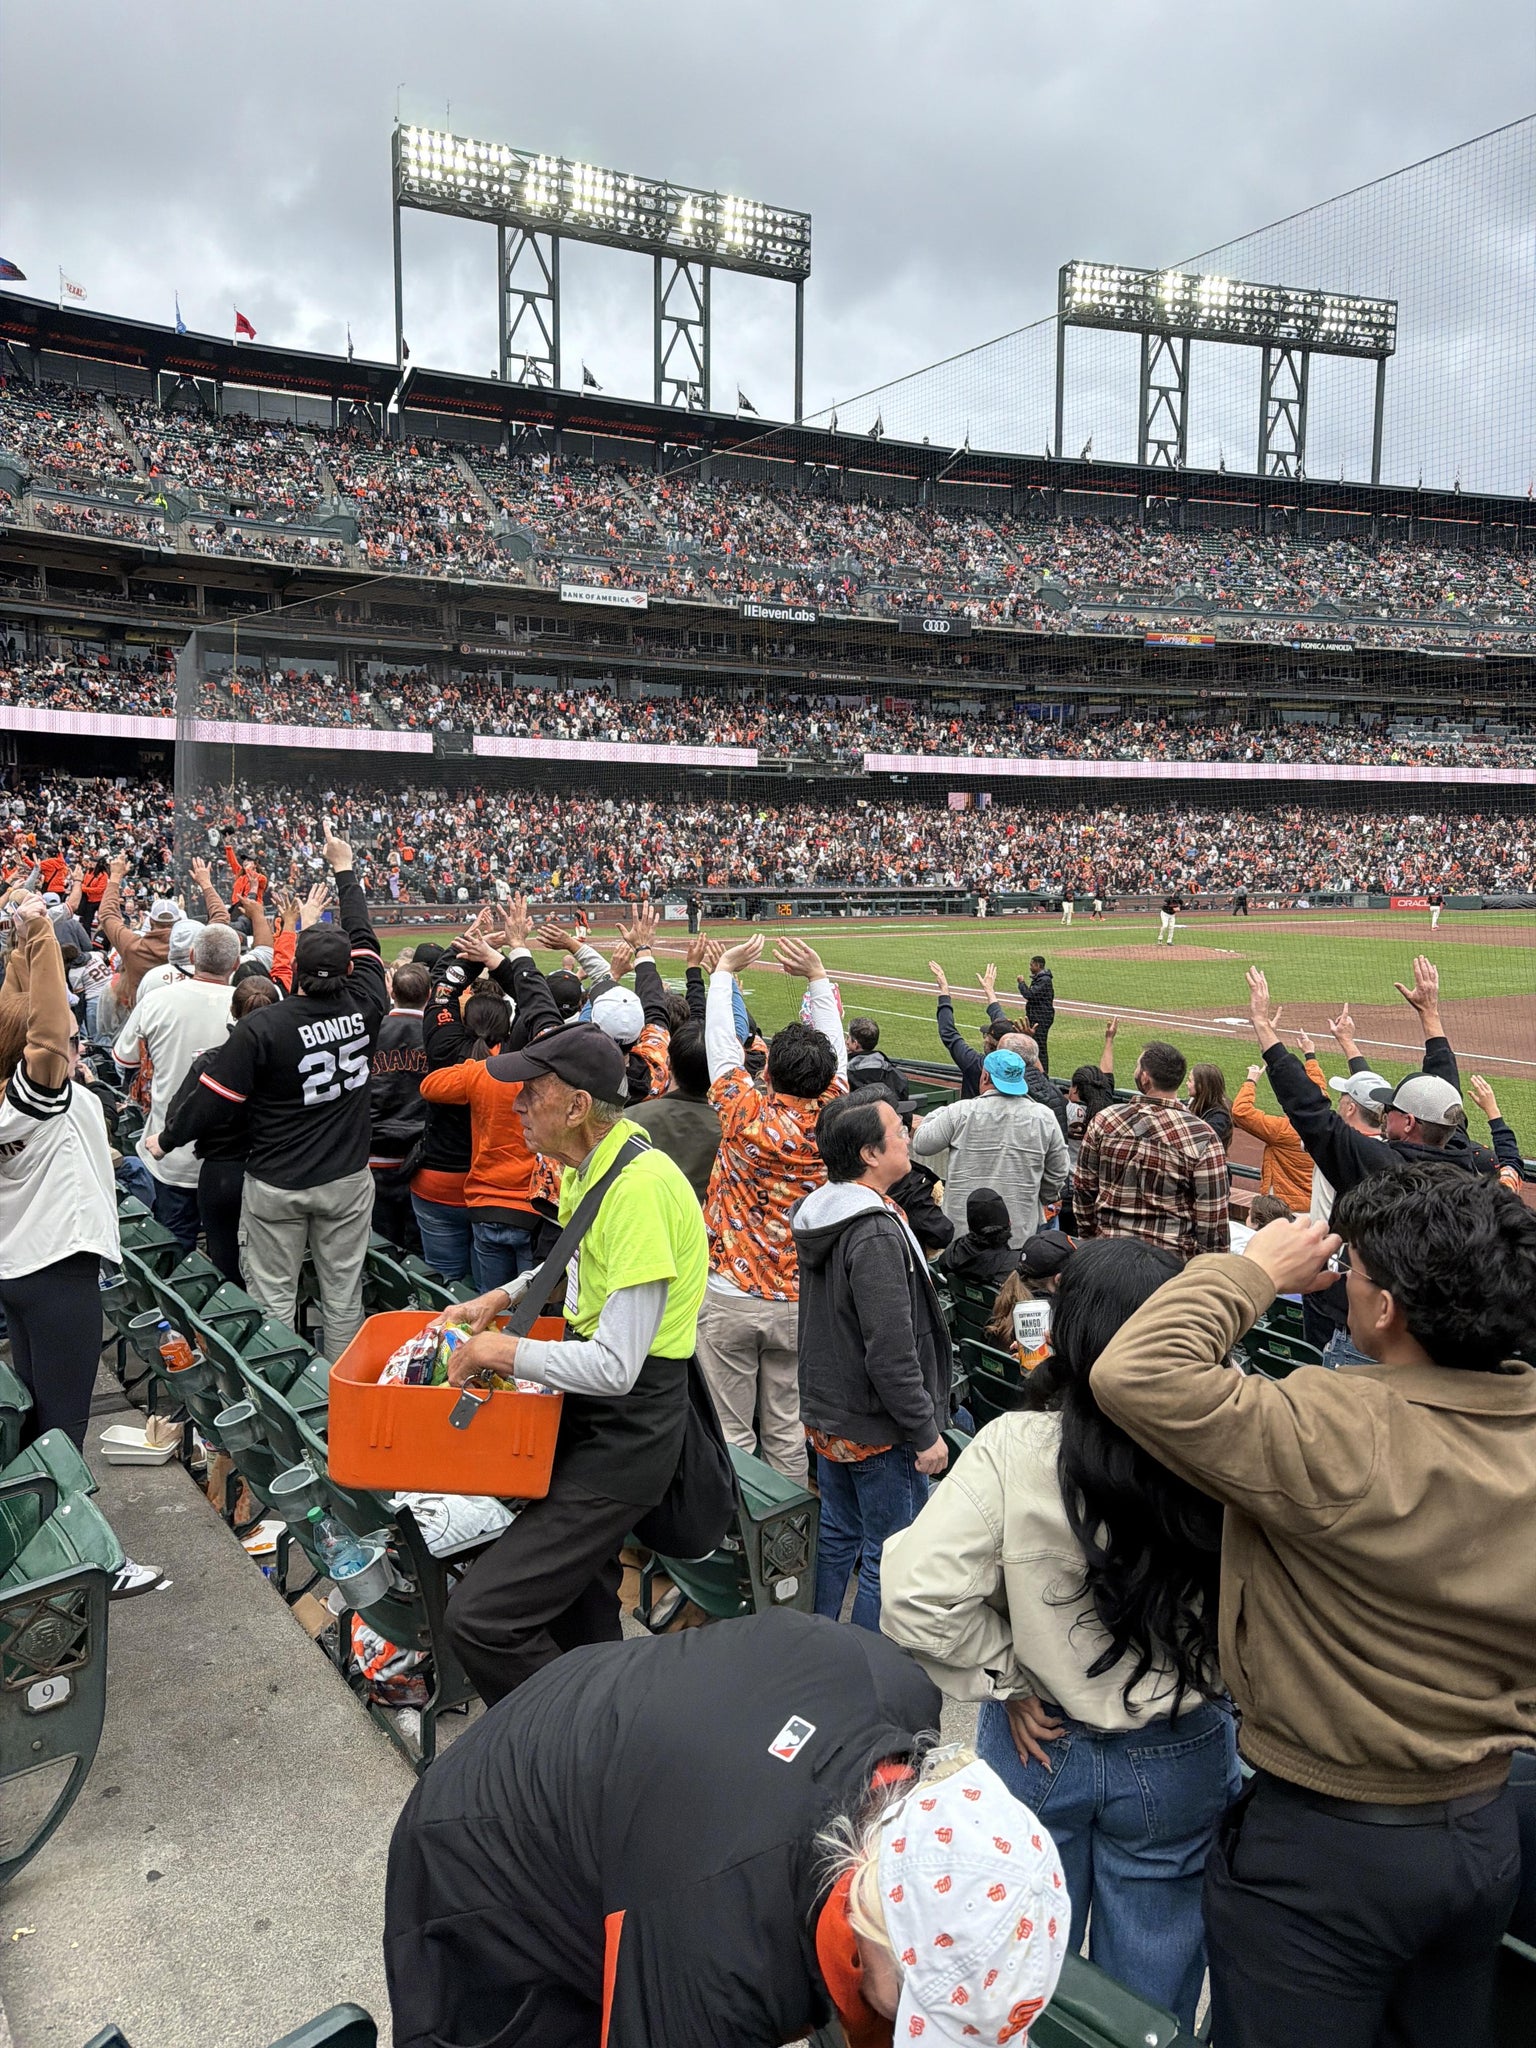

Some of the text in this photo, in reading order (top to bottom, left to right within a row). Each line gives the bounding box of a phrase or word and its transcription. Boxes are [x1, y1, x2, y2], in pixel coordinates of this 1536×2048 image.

[562, 591, 584, 599] BANK
[596, 595, 630, 603] AMERICA
[1301, 642, 1353, 651] KONICA MINOLTA
[1397, 899, 1431, 907] ORACL
[298, 1012, 366, 1049] BONDS
[298, 1034, 370, 1106] 25
[757, 1189, 770, 1206] 9
[1022, 1318, 1041, 1328] MANGO
[1019, 1328, 1046, 1338] MARGARIT
[42, 1684, 54, 1703] 9
